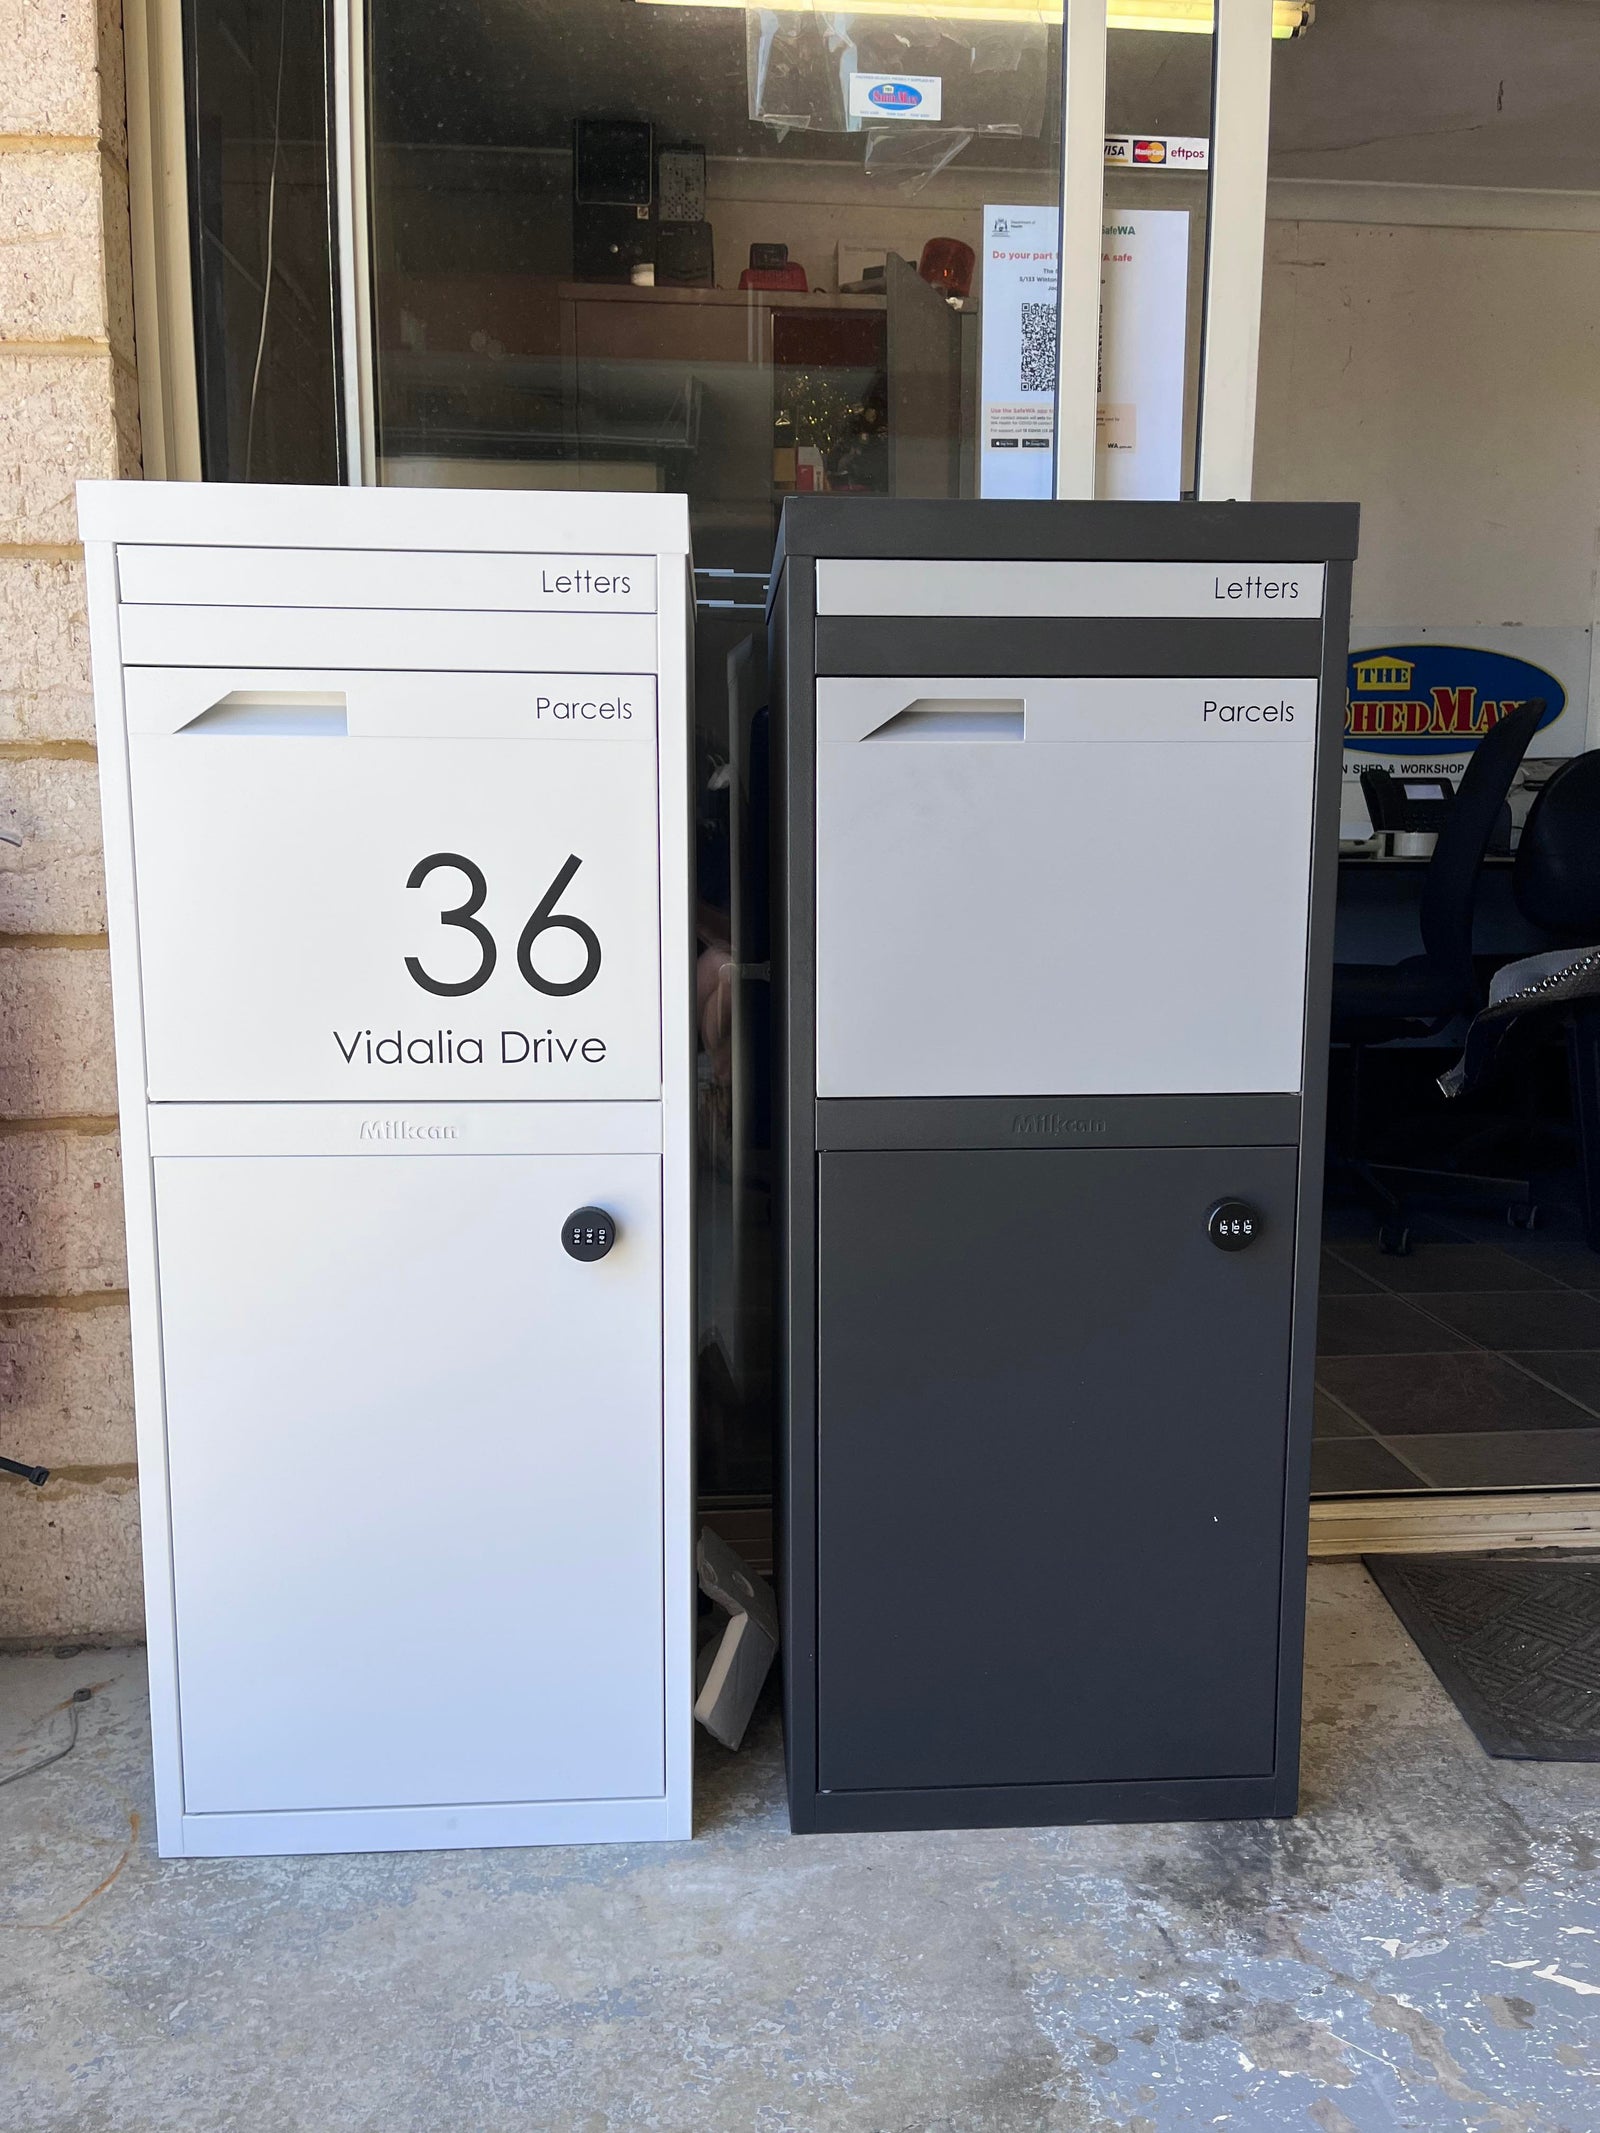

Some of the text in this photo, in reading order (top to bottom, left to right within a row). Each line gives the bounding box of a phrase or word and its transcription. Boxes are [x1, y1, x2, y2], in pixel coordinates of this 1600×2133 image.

[1171, 146, 1205, 160] eftpos
[992, 250, 1006, 259] Do
[1008, 252, 1030, 262] your
[1033, 252, 1053, 262] part
[1113, 253, 1133, 262] safe
[541, 569, 631, 594] Letters
[1214, 576, 1299, 599] Letters
[1360, 667, 1409, 685] THE
[536, 696, 633, 720] Parcels
[1203, 700, 1295, 723] Parcels
[1388, 764, 1395, 774] &
[1400, 763, 1465, 774] WORKSHOP
[404, 852, 602, 997] 36
[333, 1028, 607, 1064] Vidalia Drive
[359, 1119, 458, 1140] Milkcan
